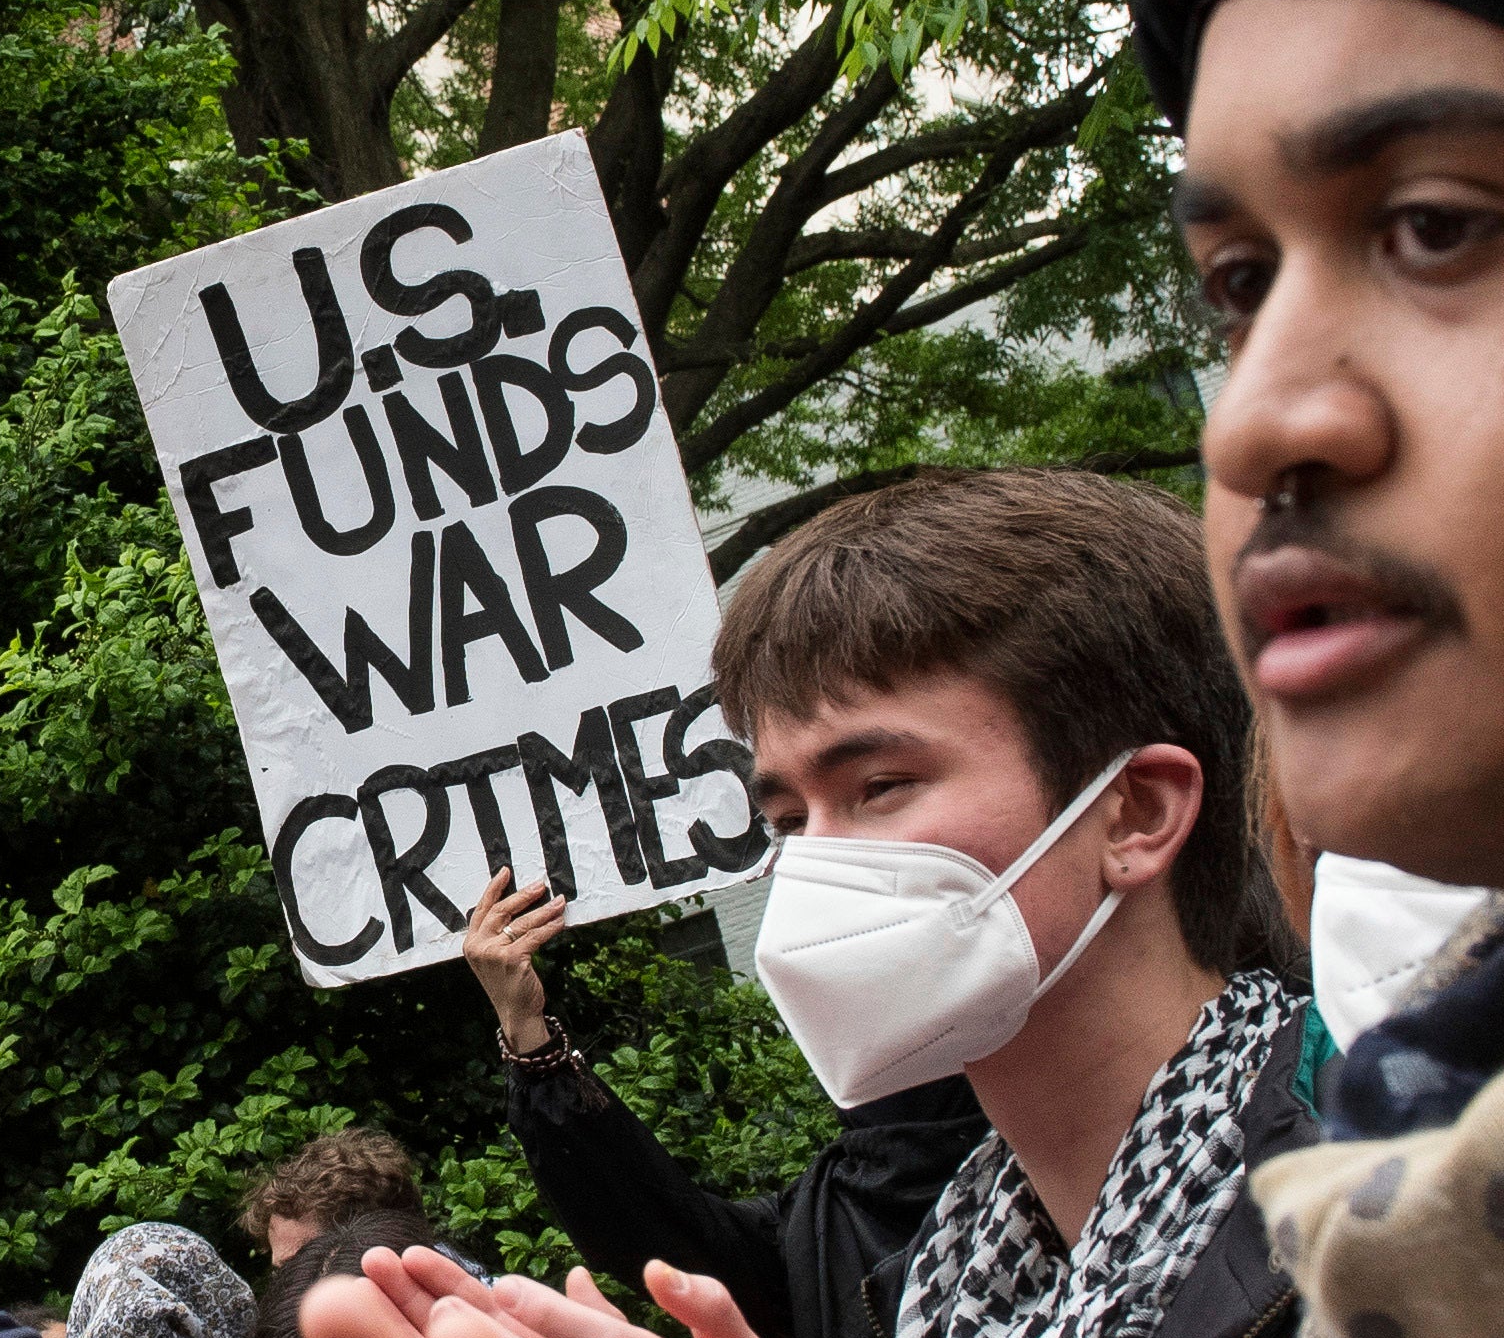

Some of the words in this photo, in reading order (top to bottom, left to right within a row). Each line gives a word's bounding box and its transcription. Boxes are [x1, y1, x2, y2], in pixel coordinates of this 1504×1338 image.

[180, 307, 657, 589] FUNDS
[199, 203, 543, 434] U.S.
[250, 486, 644, 734] WAR
[272, 683, 769, 966] CRIMES
